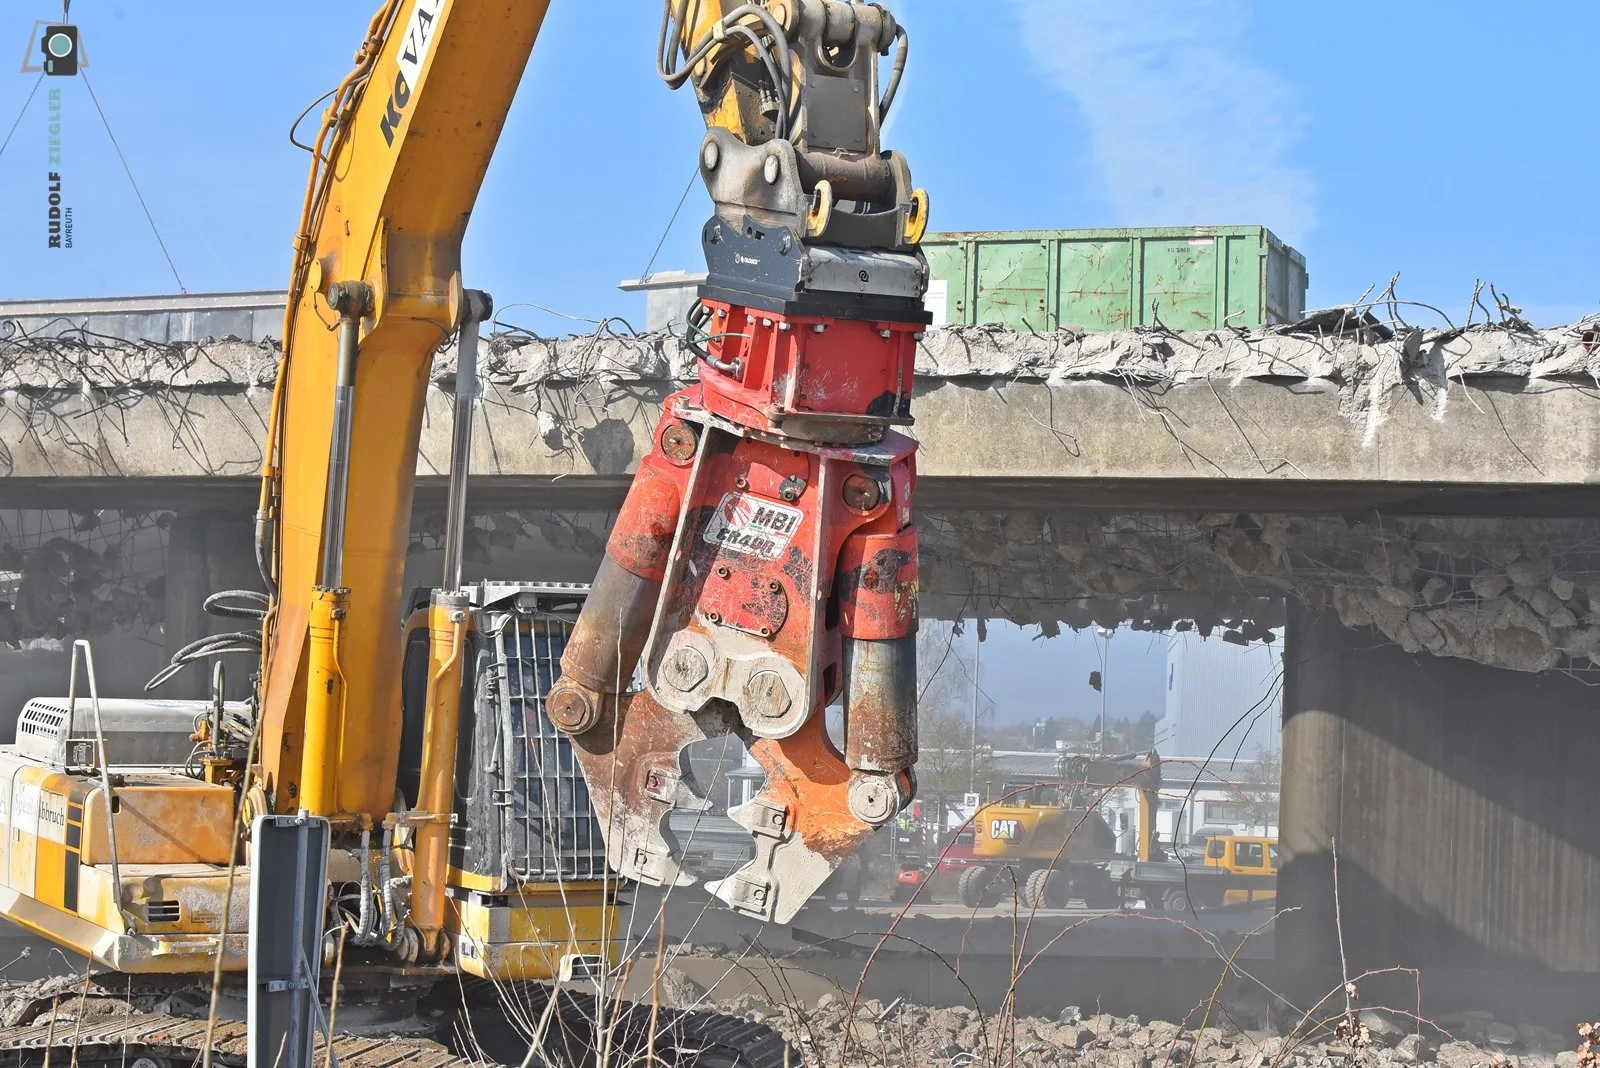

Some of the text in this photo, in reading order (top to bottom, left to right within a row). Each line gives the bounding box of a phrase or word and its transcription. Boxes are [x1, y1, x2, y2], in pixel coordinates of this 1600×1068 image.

[379, 0, 440, 149] KOVA
[752, 506, 797, 534] MBI
[991, 819, 1017, 839] CAT
